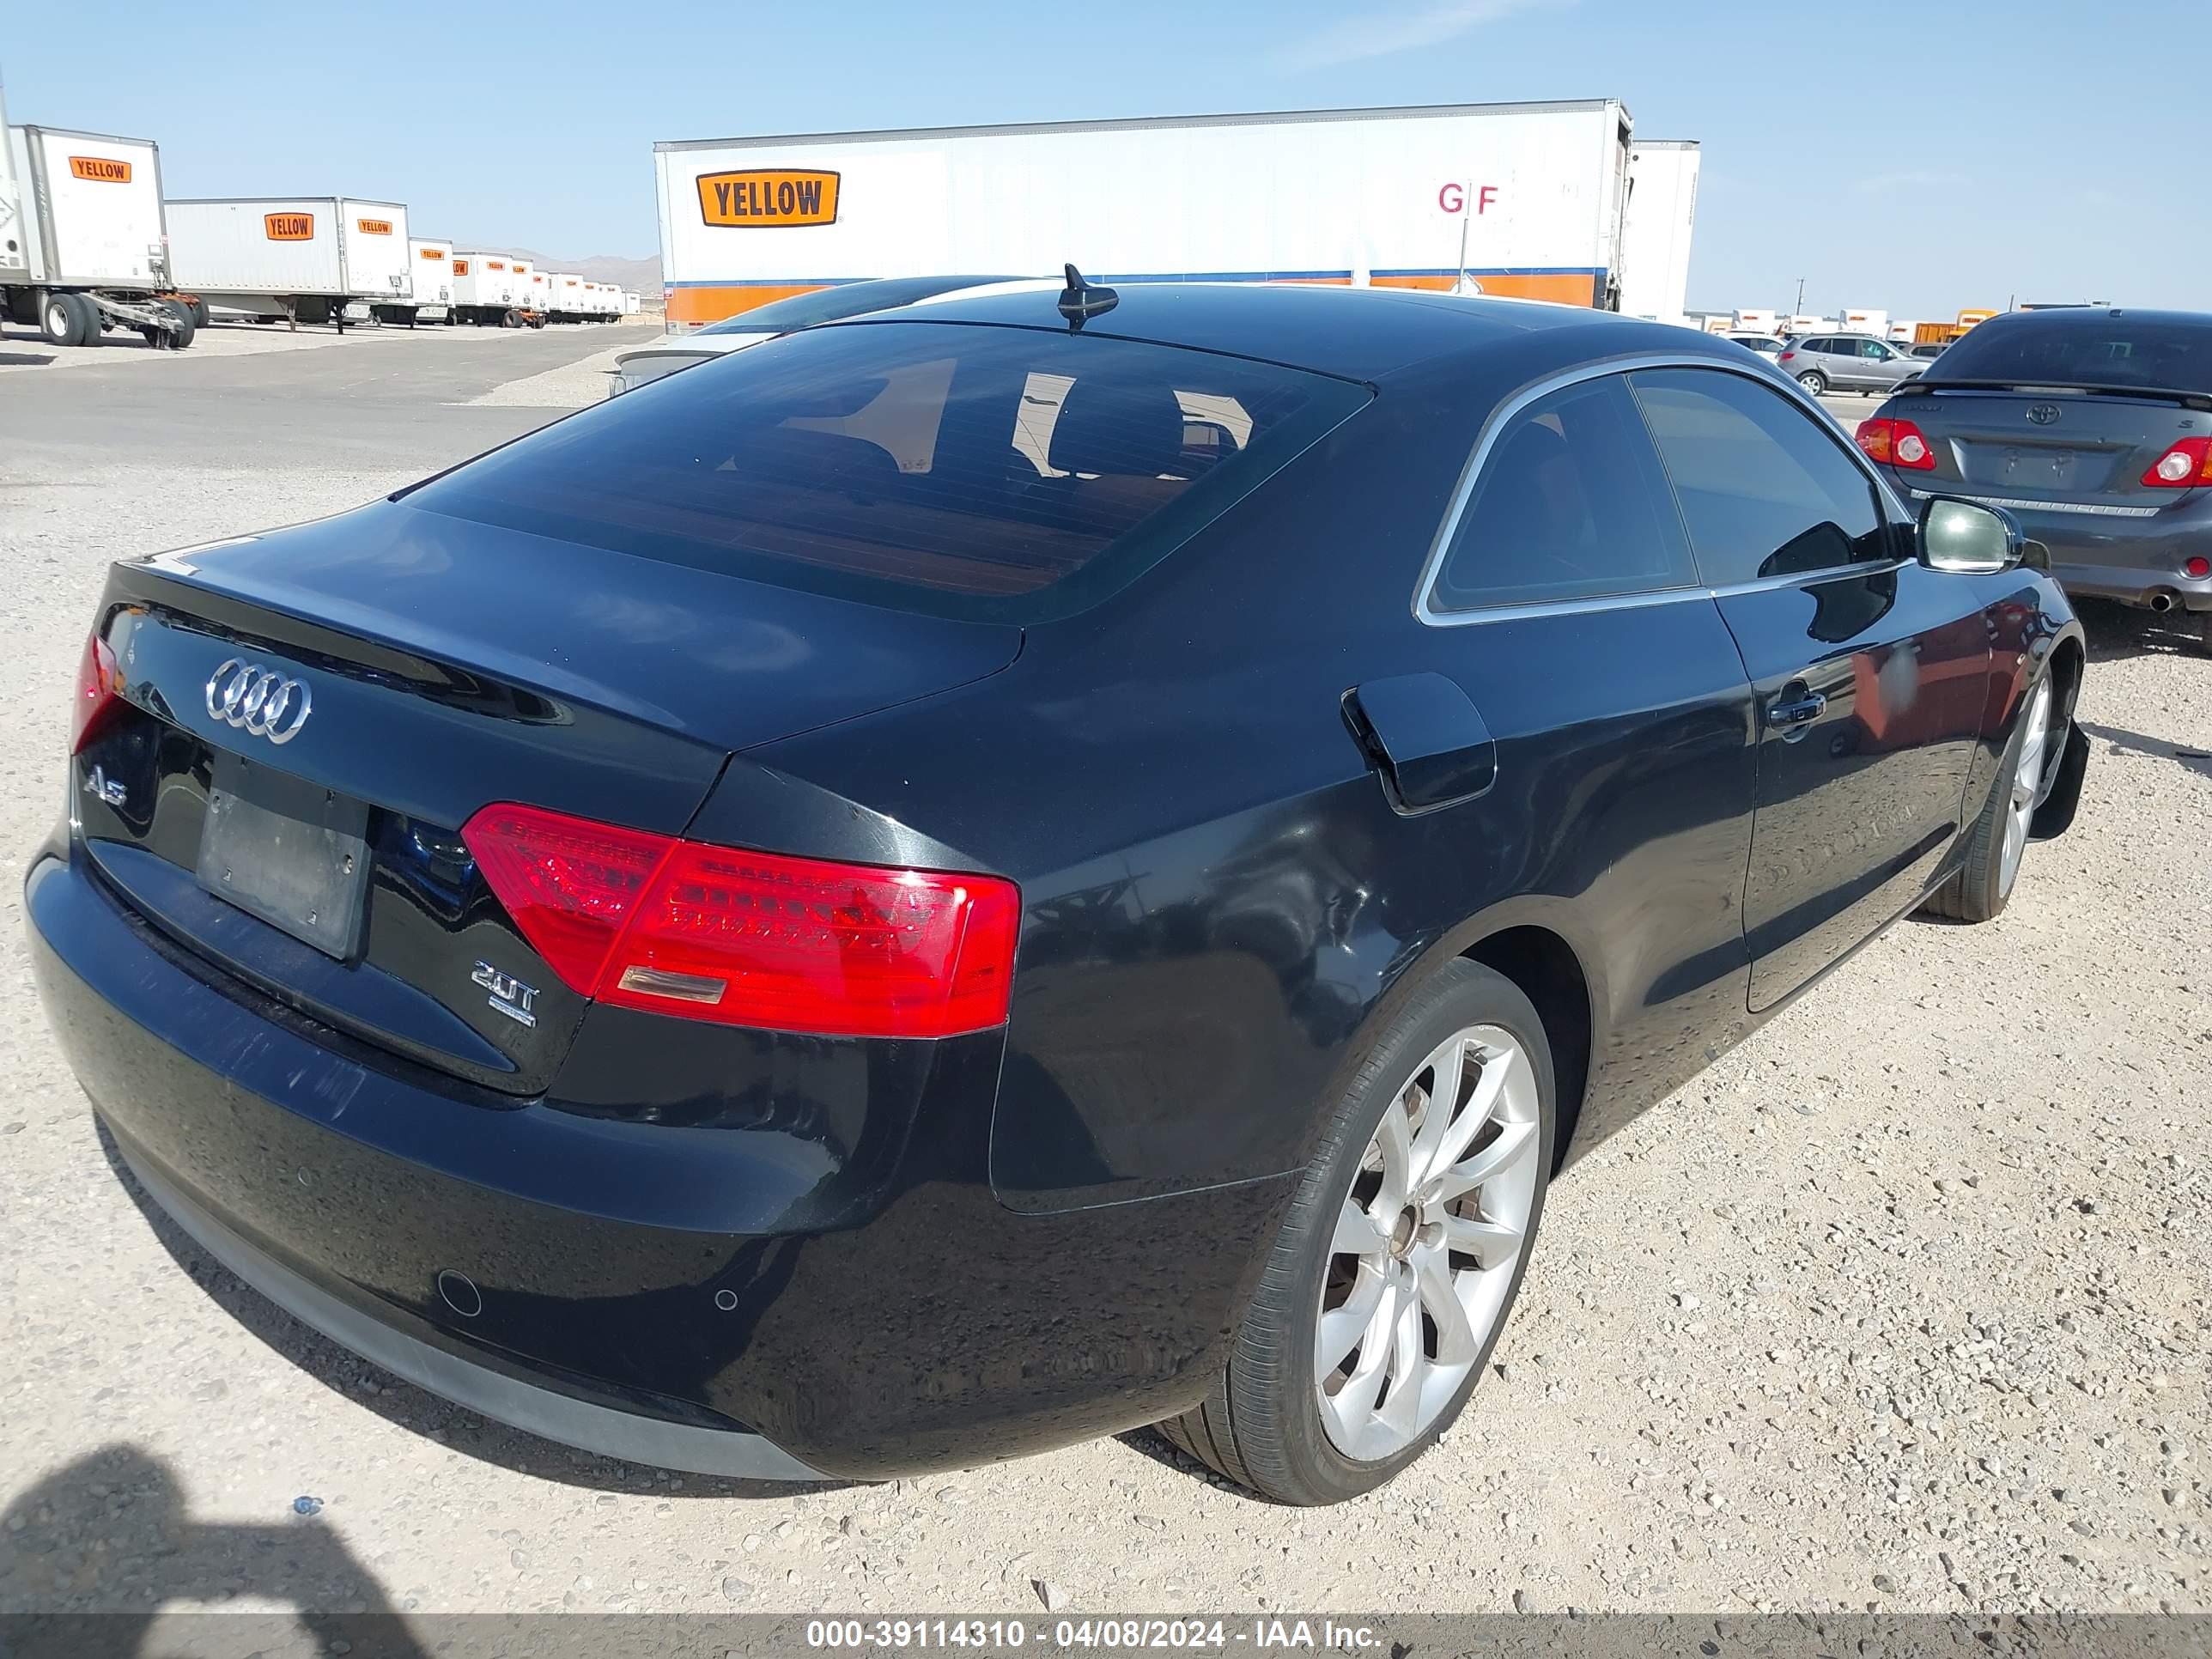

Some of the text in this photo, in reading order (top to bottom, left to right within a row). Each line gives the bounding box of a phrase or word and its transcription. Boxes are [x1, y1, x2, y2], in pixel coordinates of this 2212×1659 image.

[76, 160, 125, 179] YELLOW
[714, 172, 822, 216] YELLOW
[1439, 183, 1498, 215] G F
[270, 217, 308, 236] YELLOW
[362, 222, 389, 233] YELLOW
[422, 250, 442, 259] YELLOW
[83, 765, 127, 805] A5
